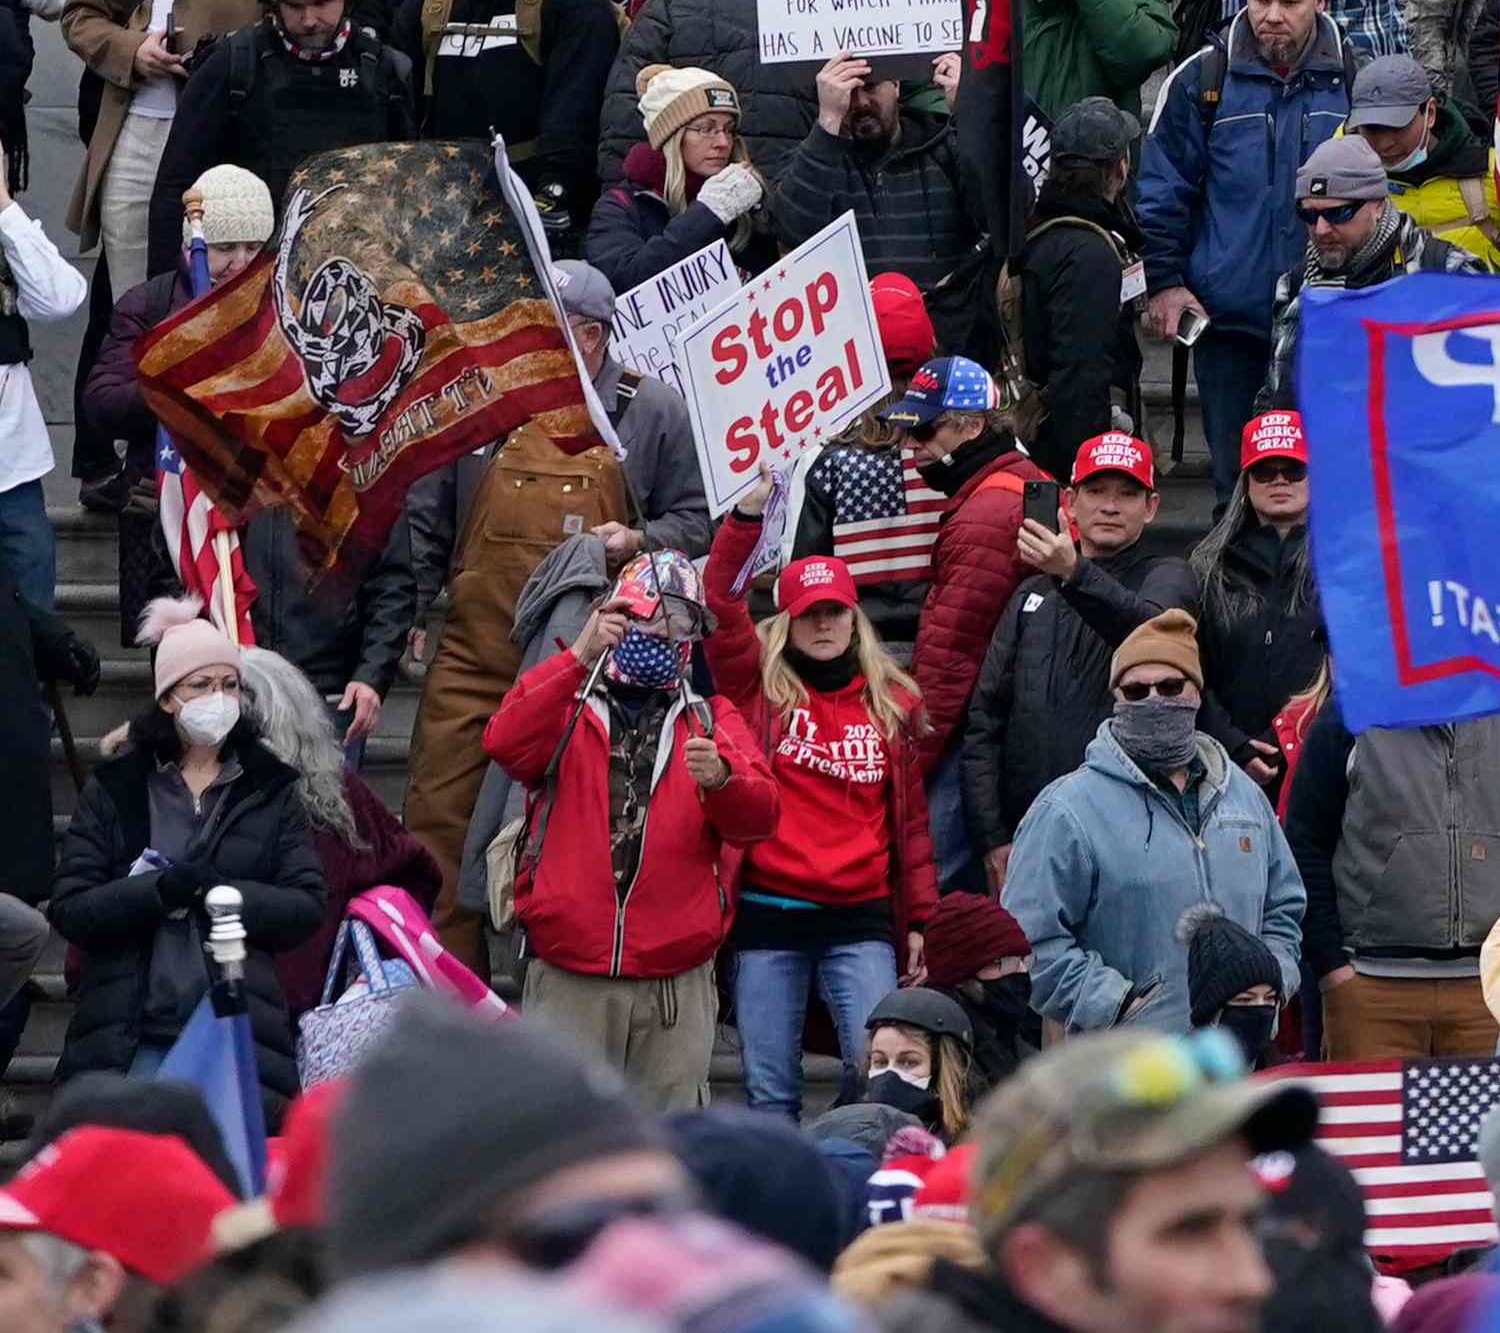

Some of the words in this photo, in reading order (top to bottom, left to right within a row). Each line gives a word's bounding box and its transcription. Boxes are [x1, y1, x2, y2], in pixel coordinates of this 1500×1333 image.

[762, 30, 799, 58] HAS
[813, 29, 824, 52] A
[834, 24, 905, 50] VACCINE
[912, 23, 936, 45] TO
[655, 243, 728, 315] INJURY
[704, 269, 841, 385] Stop
[765, 341, 813, 391] the
[724, 338, 865, 475] Steal
[1260, 413, 1292, 428] KEEP
[1101, 434, 1134, 446] KEEP
[1250, 426, 1303, 443] AMERICA
[1089, 444, 1143, 461] AMERICA
[1256, 437, 1296, 452] GREAT
[1095, 455, 1135, 468] GREAT
